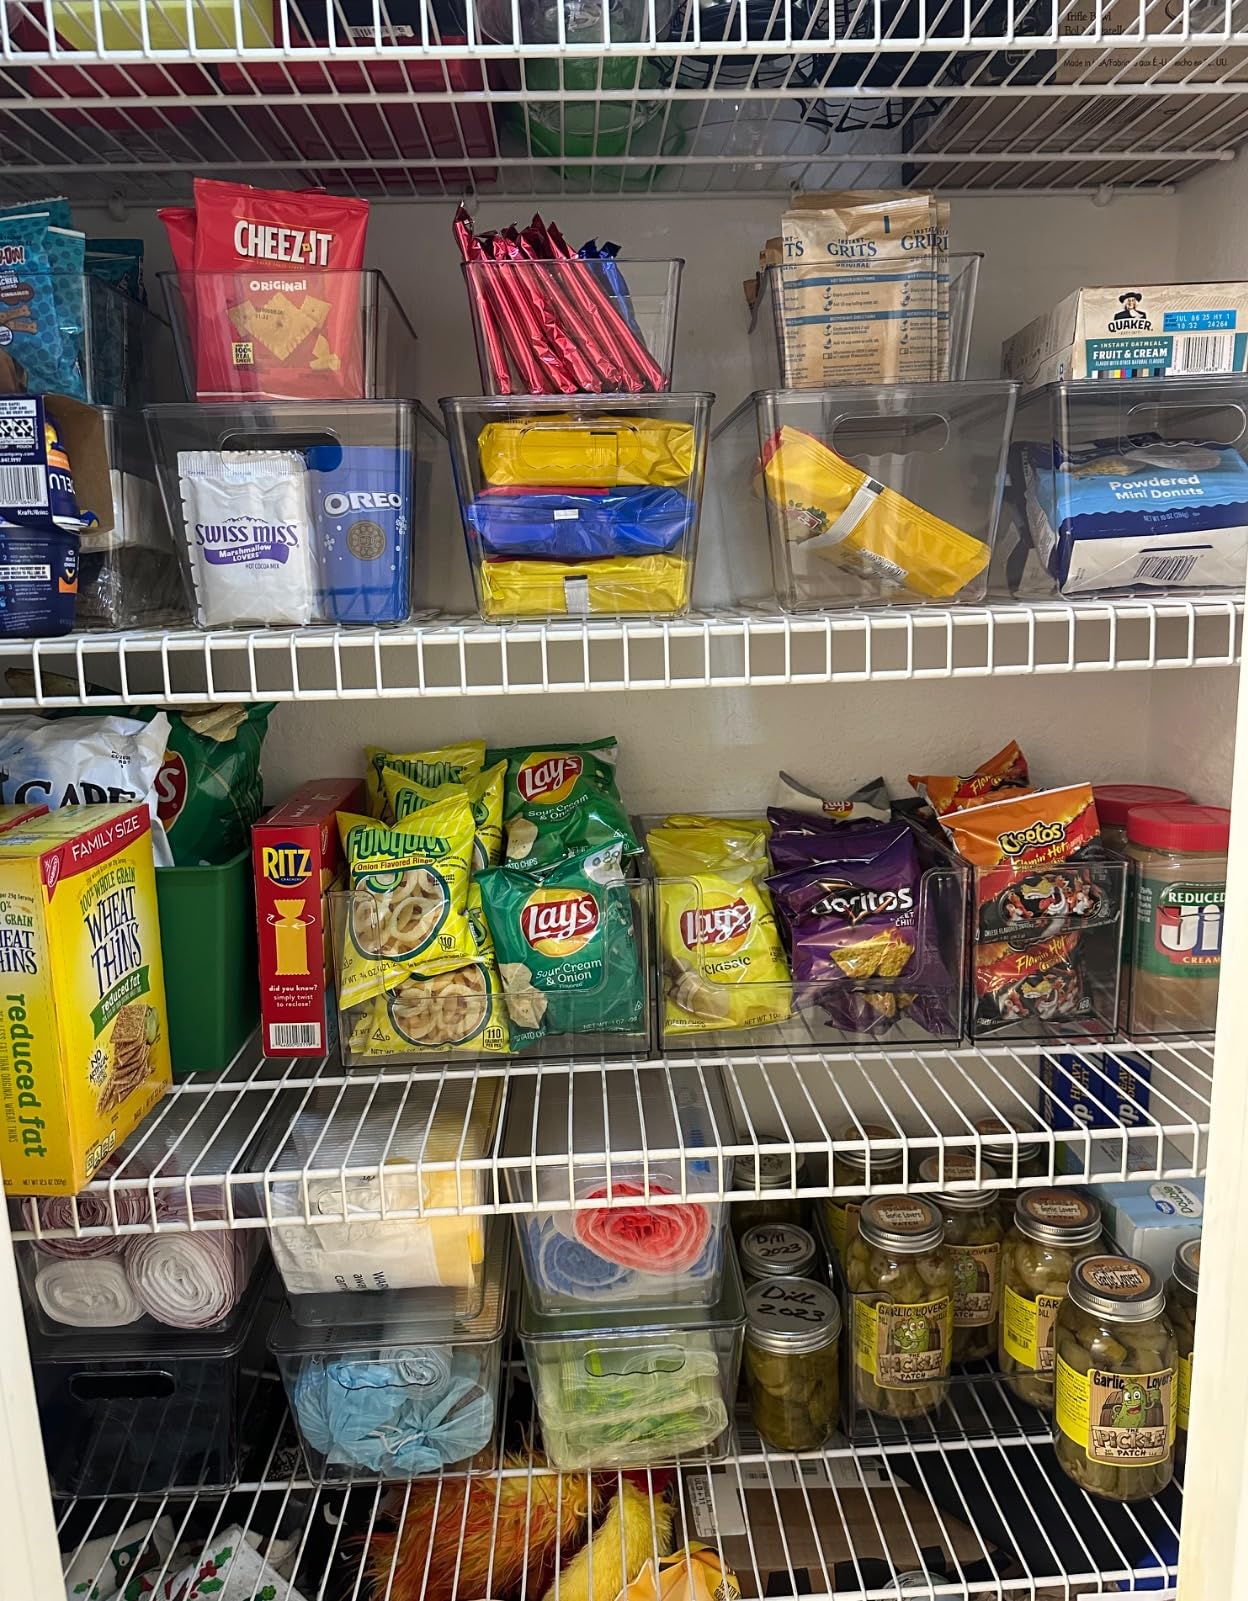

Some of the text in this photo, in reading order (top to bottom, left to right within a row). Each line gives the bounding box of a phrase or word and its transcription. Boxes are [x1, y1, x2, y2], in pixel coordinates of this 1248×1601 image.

[1090, 11, 1112, 22] Bwl
[827, 241, 877, 258] GRITS
[838, 237, 865, 245] INSTANT
[1108, 319, 1152, 333] QUAKER
[1093, 348, 1168, 360] FRUIT & CREAM
[1109, 474, 1201, 491] Powdered
[1115, 486, 1205, 501] Mini Donuts
[324, 491, 403, 518] OREO
[196, 523, 249, 546] SWISS
[219, 544, 272, 558] Marshmallow
[232, 552, 260, 562] LOVERS
[524, 757, 579, 797] Lay's
[528, 794, 589, 817] Sour Cream
[72, 815, 141, 862] FAMILY SIZE
[998, 821, 1064, 855] Cheetos
[1047, 842, 1067, 859] Hot
[262, 846, 313, 880] RITZ
[357, 858, 411, 871] Onion Flavored
[520, 857, 538, 869] CHIPS
[94, 871, 115, 897] WHOLE
[117, 867, 136, 885] GRAIN
[5, 914, 33, 927] GRAIN
[84, 886, 137, 949] WHEAT
[529, 900, 593, 941] Lay's
[535, 958, 602, 979] Sour Cream
[546, 970, 592, 986] & Onion
[101, 977, 129, 1014] reduced
[129, 973, 141, 990] fat
[296, 984, 318, 992] know?
[488, 1029, 501, 1037] 110
[91, 1049, 102, 1068] NO
[6, 993, 47, 1157] reduced fat
[2, 1073, 14, 1100] ORIGINAL
[4, 1103, 15, 1124] WHEAT
[8, 1125, 18, 1143] THINS
[904, 1211, 922, 1219] Lovers
[756, 1232, 785, 1245] Dill
[759, 1243, 802, 1257] 2023
[761, 1285, 817, 1306] Dill
[757, 1304, 826, 1323] 2023
[878, 1302, 948, 1318] GARLIC LOVERS
[1093, 1371, 1174, 1390] Garlic Lovers
[1117, 1449, 1146, 1457] PATCH
